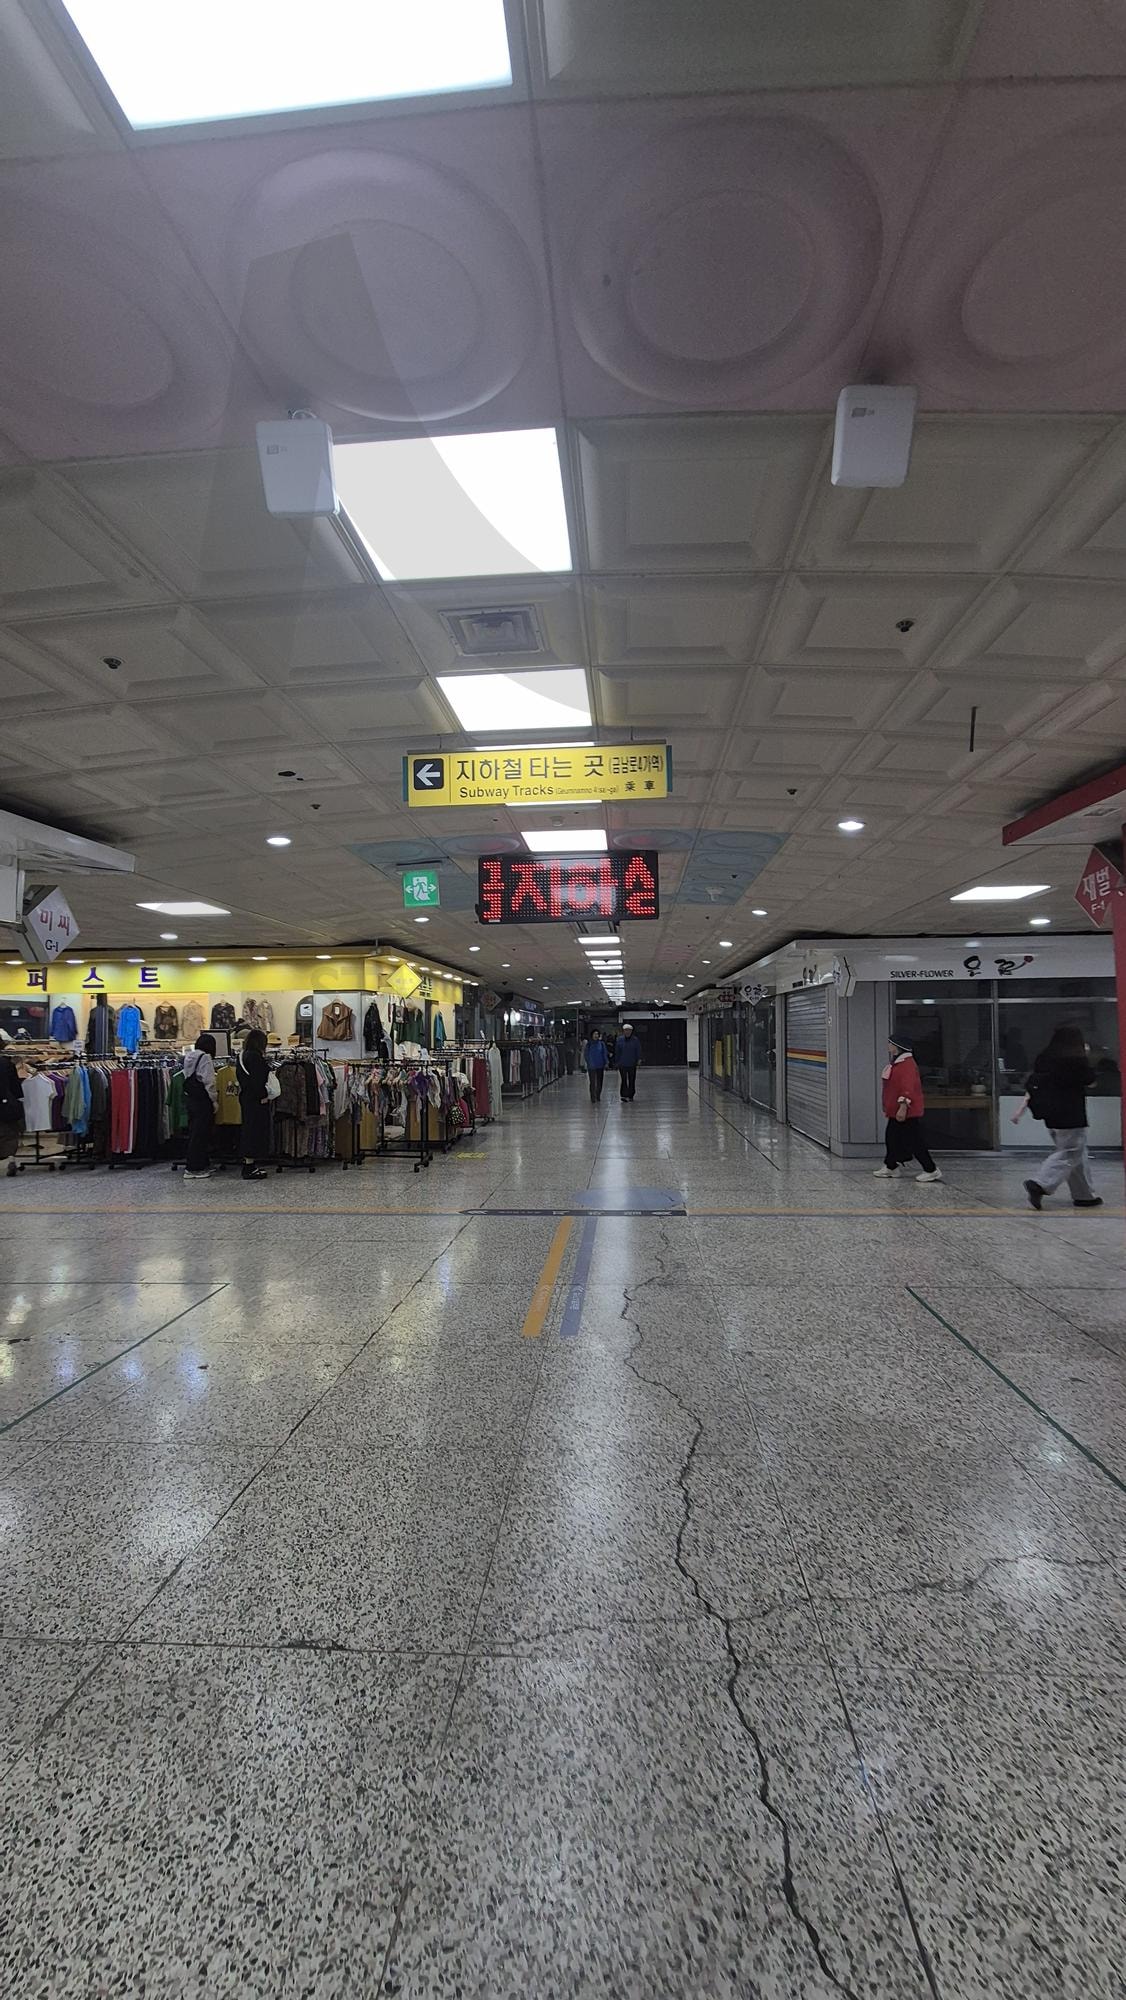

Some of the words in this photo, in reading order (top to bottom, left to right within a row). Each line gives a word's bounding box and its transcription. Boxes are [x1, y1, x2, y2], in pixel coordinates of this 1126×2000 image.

[456, 759, 522, 781] 지하철
[530, 757, 573, 778] 타는
[584, 755, 604, 777] 곳
[460, 786, 509, 799] Subway
[512, 784, 554, 796] Tracks
[890, 970, 954, 979] SILVER-FLOWER
